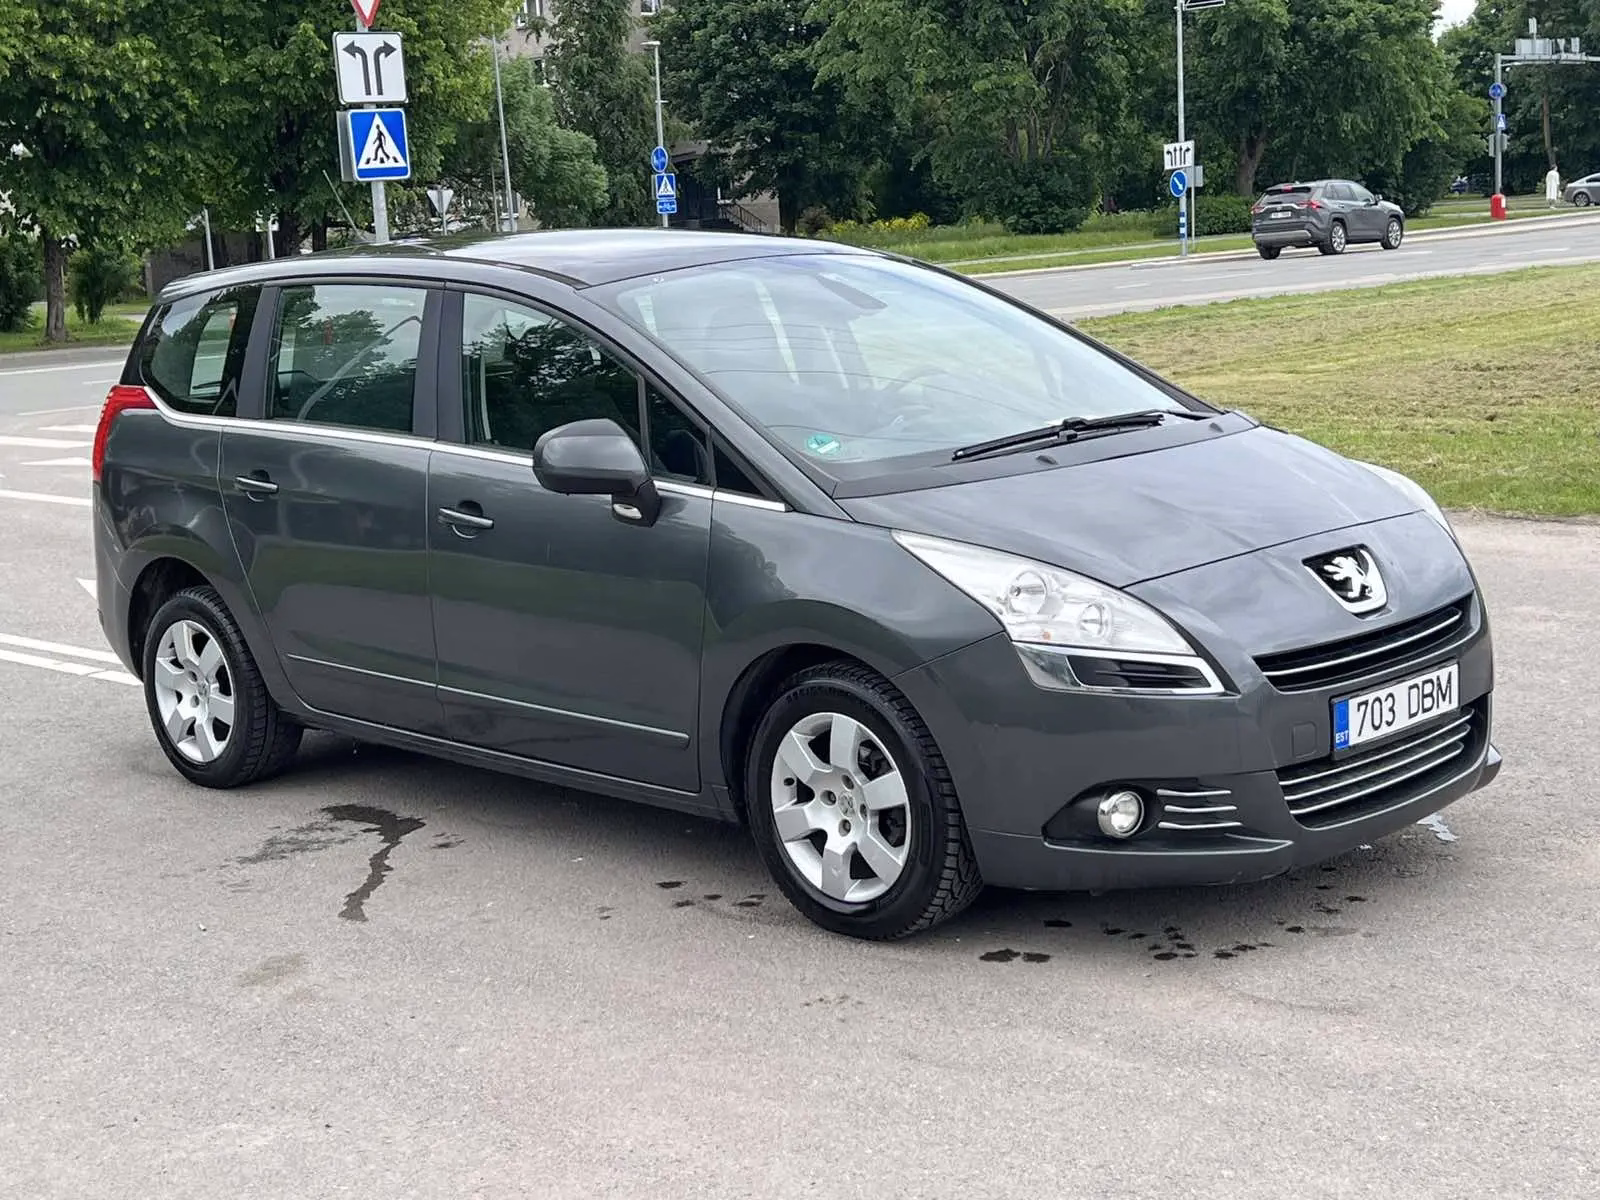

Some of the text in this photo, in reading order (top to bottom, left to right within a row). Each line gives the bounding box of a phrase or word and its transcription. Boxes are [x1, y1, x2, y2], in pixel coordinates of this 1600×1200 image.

[1357, 671, 1452, 737] 703 DBM
[1335, 730, 1349, 743] EST
